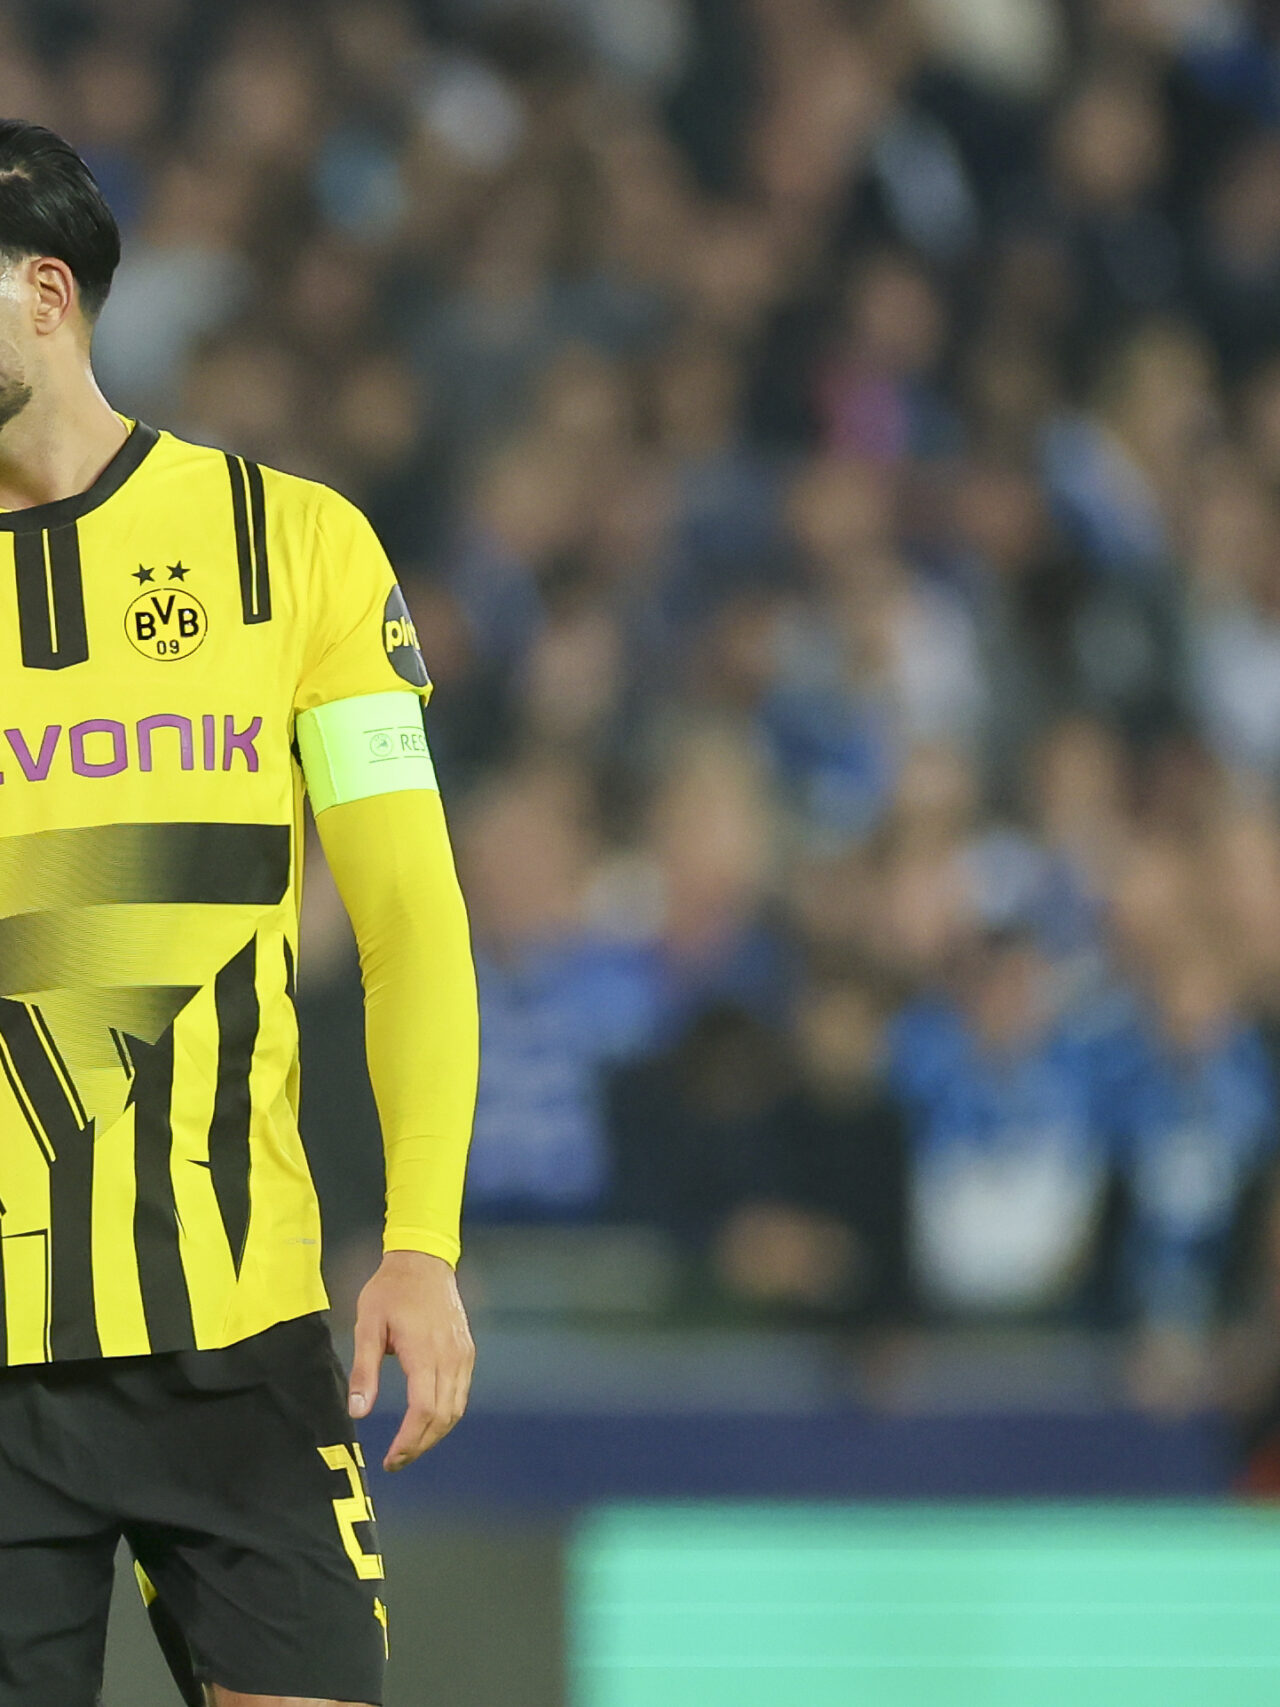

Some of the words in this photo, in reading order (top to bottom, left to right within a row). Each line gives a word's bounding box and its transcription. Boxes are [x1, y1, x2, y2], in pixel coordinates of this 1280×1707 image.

[135, 594, 199, 641] BVB
[157, 639, 180, 655] 09
[316, 1442, 385, 1580] 2
